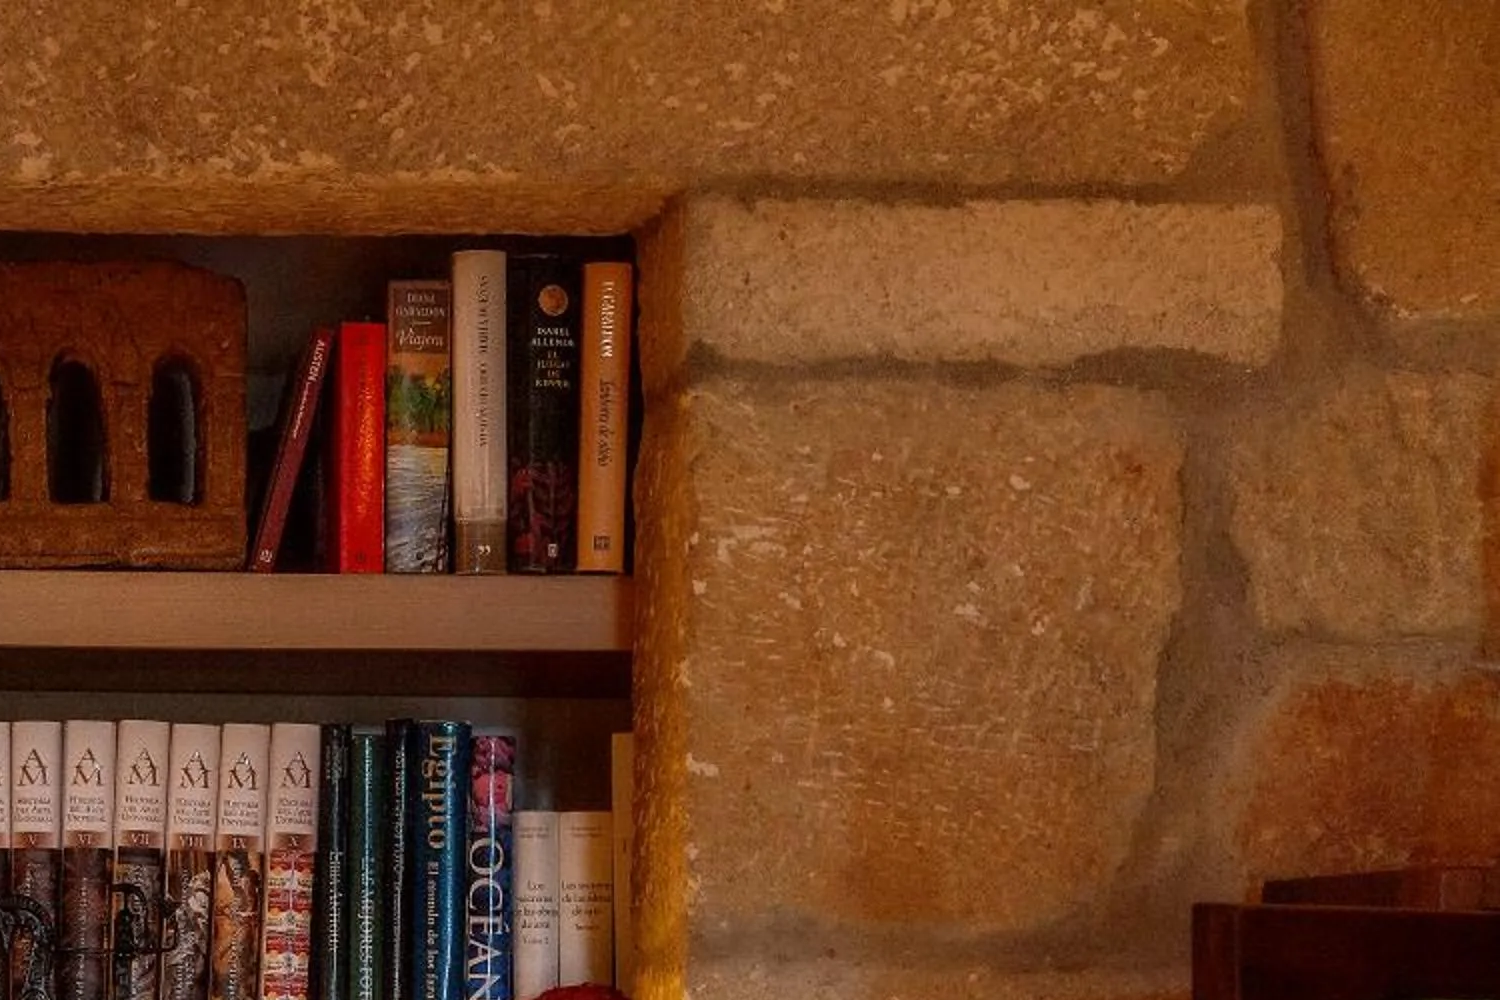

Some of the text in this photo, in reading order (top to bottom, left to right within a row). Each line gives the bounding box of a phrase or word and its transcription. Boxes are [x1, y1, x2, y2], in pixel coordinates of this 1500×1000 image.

[420, 733, 457, 849] Egipto
[28, 834, 37, 845] V
[78, 834, 93, 845] VI
[131, 834, 149, 845] VII
[179, 836, 204, 848] VIII
[232, 837, 246, 849] IX
[288, 836, 300, 847] X
[426, 860, 438, 874] El
[426, 878, 439, 925] mundo
[357, 889, 373, 962] MEJORES
[425, 928, 439, 945] de
[424, 948, 439, 969] los
